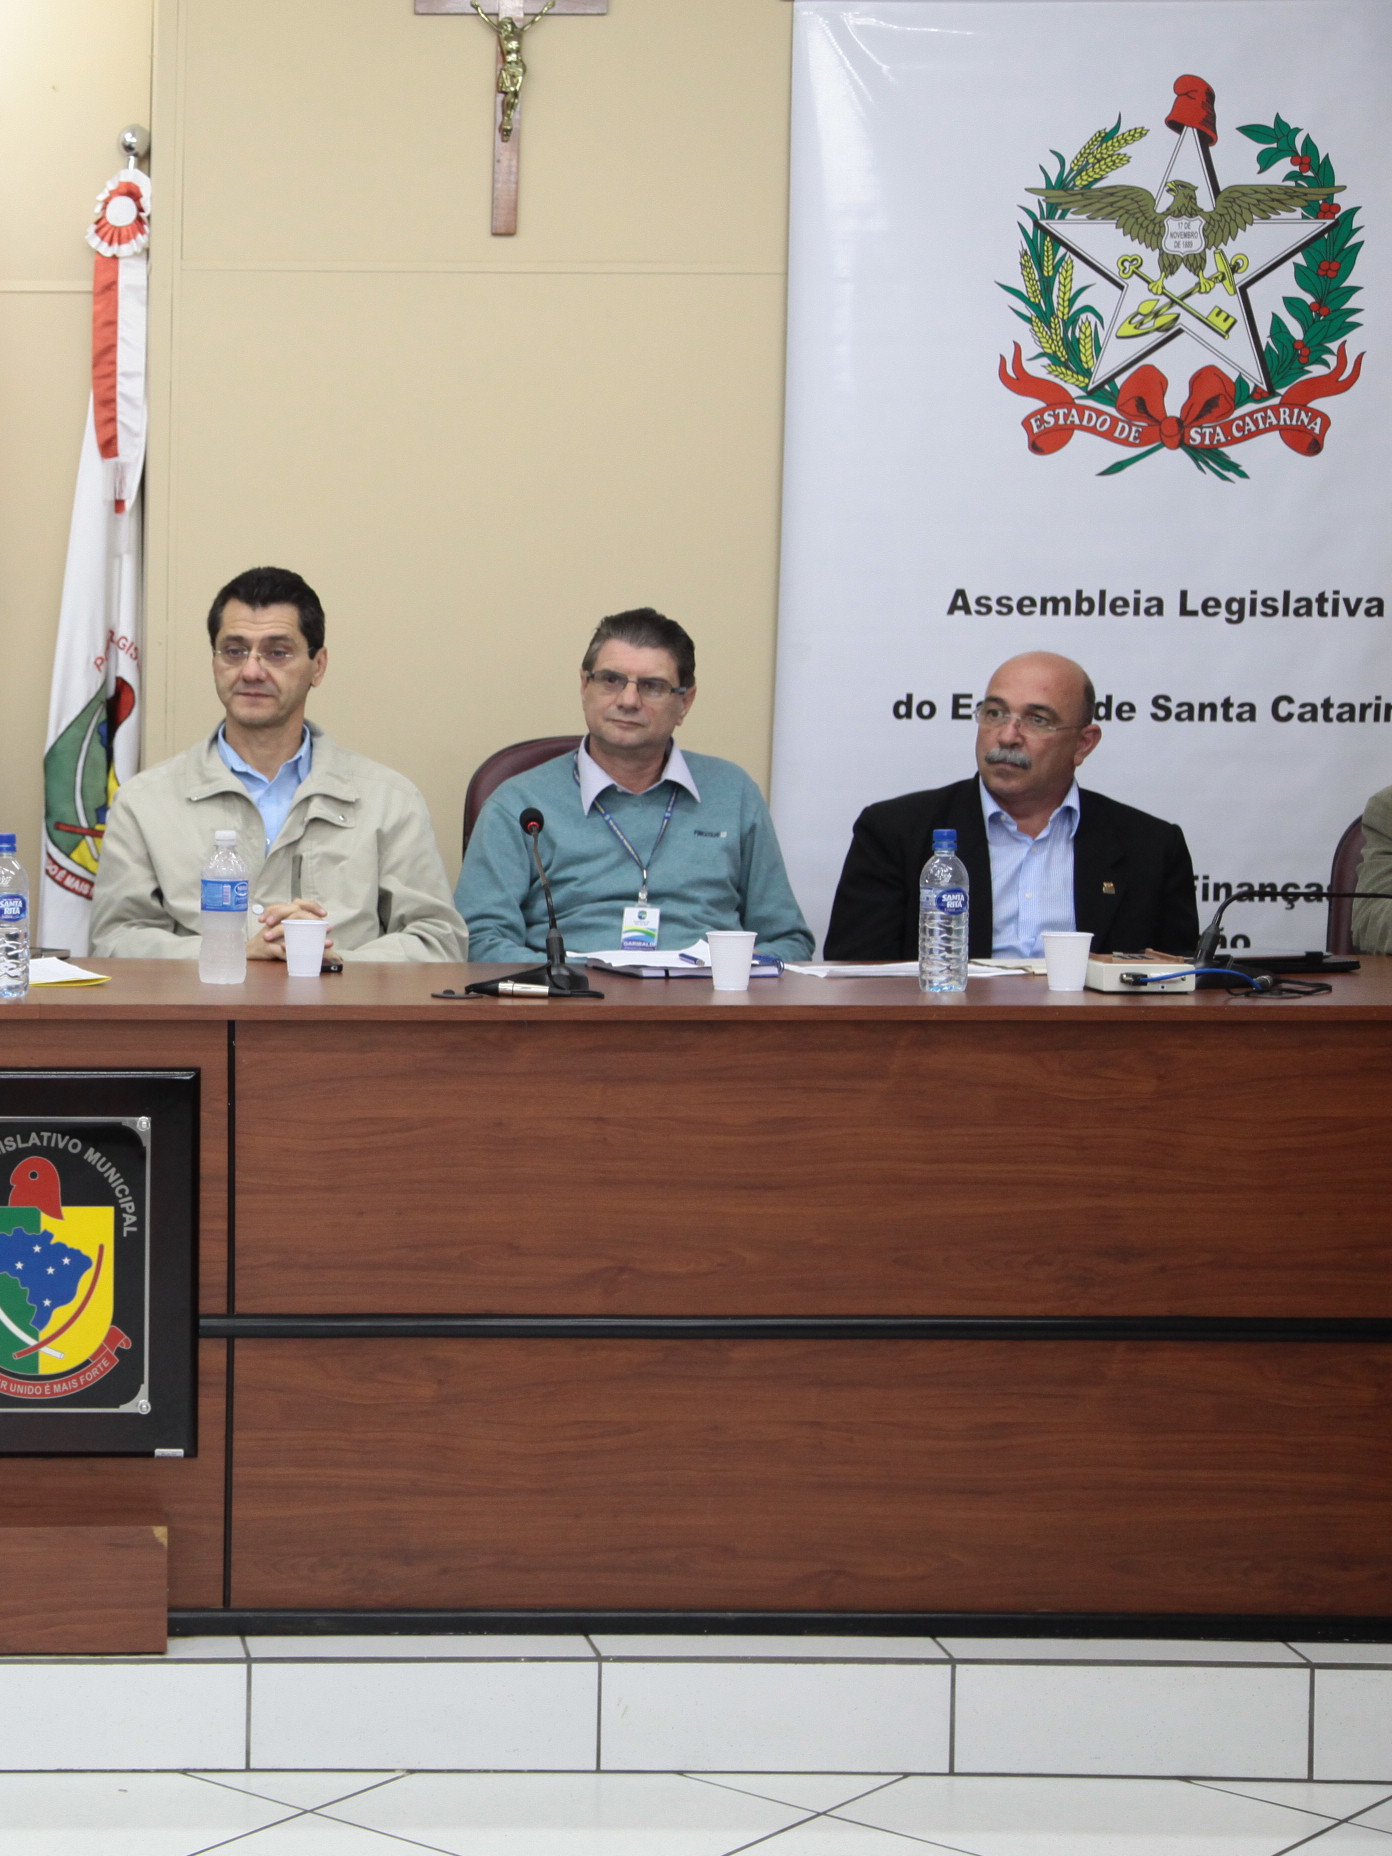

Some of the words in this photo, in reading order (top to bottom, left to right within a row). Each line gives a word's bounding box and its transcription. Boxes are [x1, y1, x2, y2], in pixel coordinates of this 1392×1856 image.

[1170, 231, 1199, 239] NOVEMBRO
[1173, 240, 1181, 249] DE
[1030, 407, 1111, 434] ESTADO
[1113, 421, 1142, 445] DE
[1232, 406, 1322, 439] CATARINA
[946, 588, 1165, 617] Assembleia
[1178, 589, 1385, 625] Legislativa
[892, 693, 937, 720] do
[1093, 694, 1137, 722] de
[1150, 694, 1257, 723] Santa
[0, 900, 23, 908] SANTA
[941, 894, 965, 902] SANTA
[1193, 875, 1332, 911] inança
[4, 907, 21, 915] RITA
[83, 1147, 138, 1237] MUNICIPAL
[9, 1383, 42, 1395] UNIDO
[44, 1383, 51, 1395] É
[53, 1378, 79, 1393] MAIS
[79, 1358, 110, 1385] FORTE
